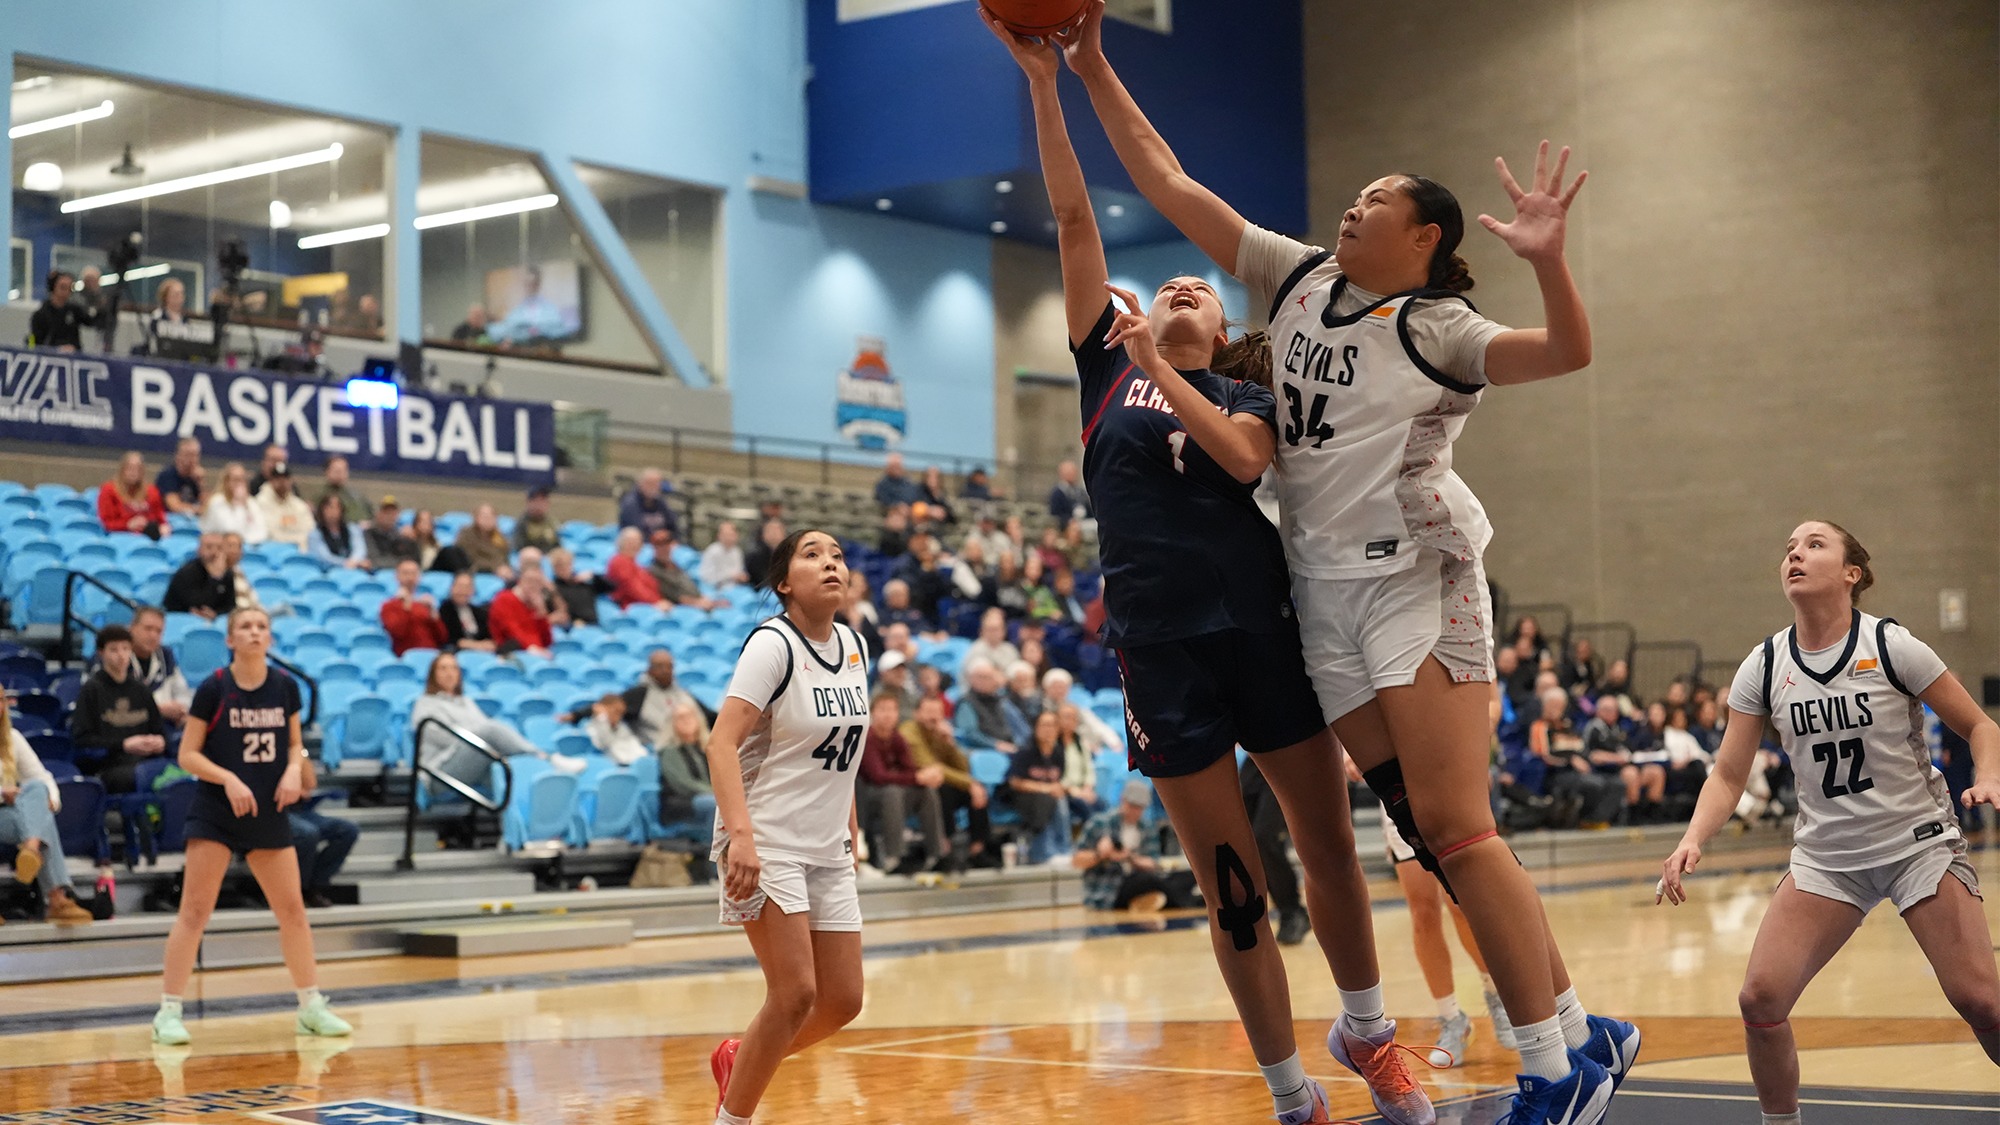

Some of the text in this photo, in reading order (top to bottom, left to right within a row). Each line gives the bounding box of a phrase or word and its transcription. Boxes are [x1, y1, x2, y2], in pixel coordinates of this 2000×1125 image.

[1285, 331, 1359, 386] DEVILS
[131, 367, 552, 471] BASKETBALL
[1283, 382, 1335, 449] 34
[1168, 430, 1187, 474] 1
[812, 686, 867, 717] DEVILS
[1790, 692, 1873, 736] DEVILS
[243, 732, 276, 763] 23
[812, 725, 863, 772] 40
[1812, 737, 1875, 799] 22
